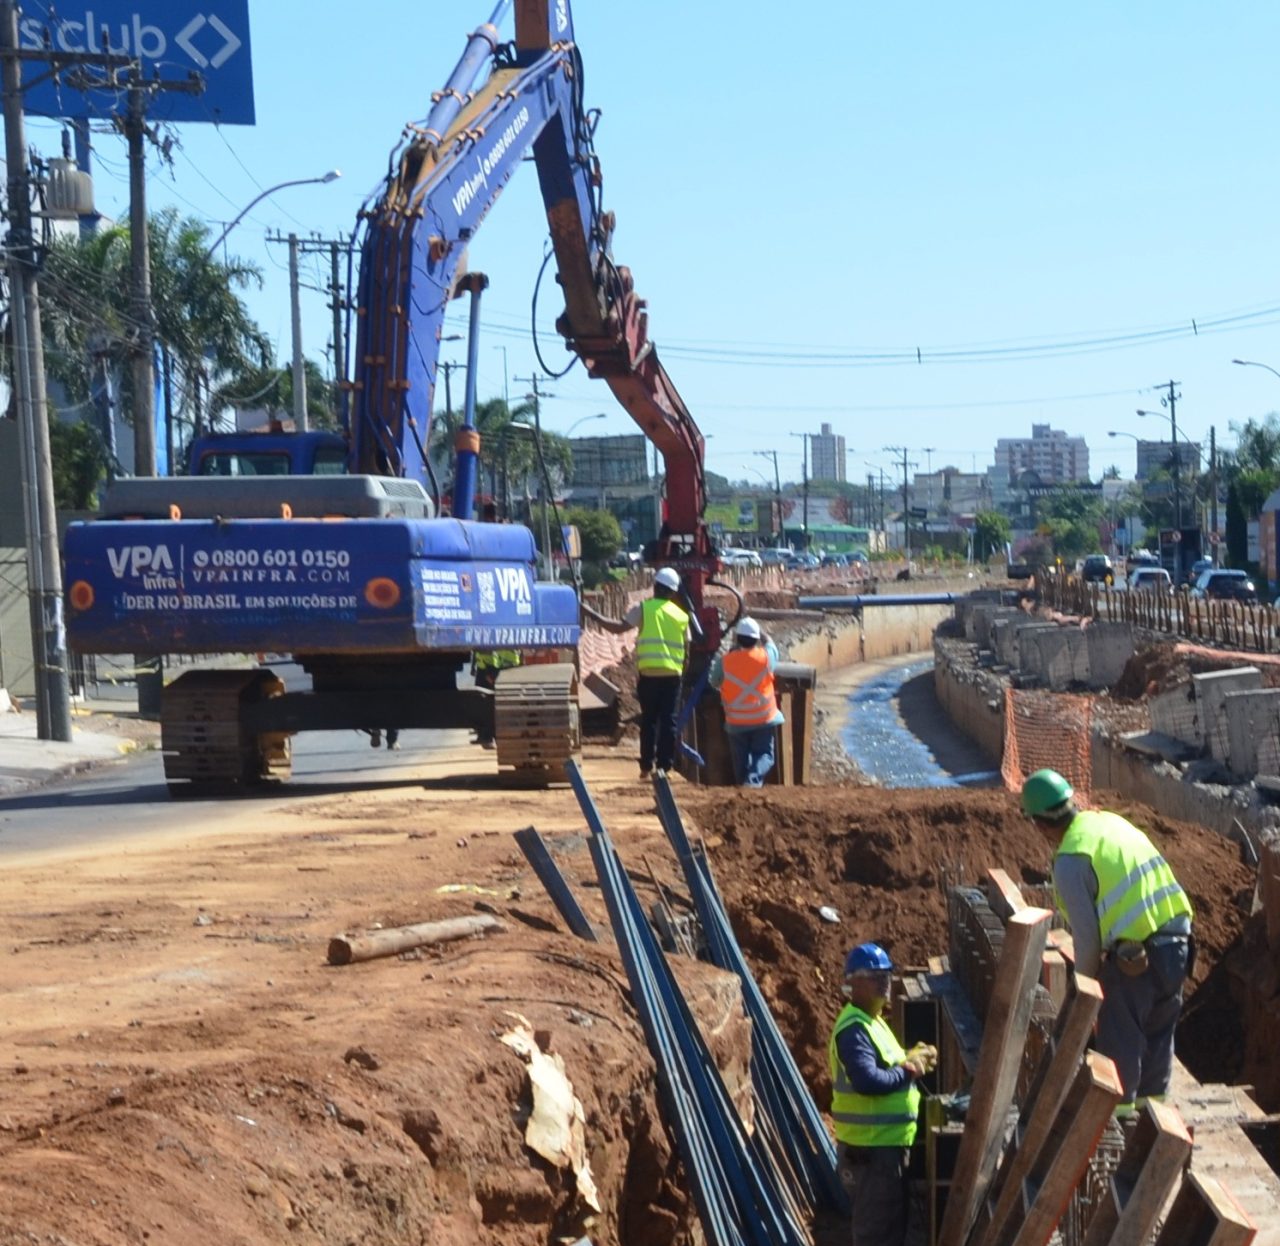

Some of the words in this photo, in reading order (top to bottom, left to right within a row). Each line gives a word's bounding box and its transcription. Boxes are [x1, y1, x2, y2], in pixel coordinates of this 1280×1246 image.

[56, 11, 167, 58] club
[452, 180, 474, 216] VPA
[107, 545, 174, 578] VPA
[212, 550, 259, 567] 0800
[263, 550, 298, 567] 601
[302, 550, 350, 568] 0150
[143, 573, 177, 591] Infra
[193, 569, 350, 583] VPAINFRA.COM
[495, 568, 531, 602] VPA
[158, 595, 180, 610] NO
[183, 594, 241, 610] BRASIL
[245, 596, 265, 609] EM
[267, 593, 337, 612] SOLUÇÕES
[339, 596, 358, 609] DE
[465, 628, 572, 646] WWW.VPAINFRA.COM
